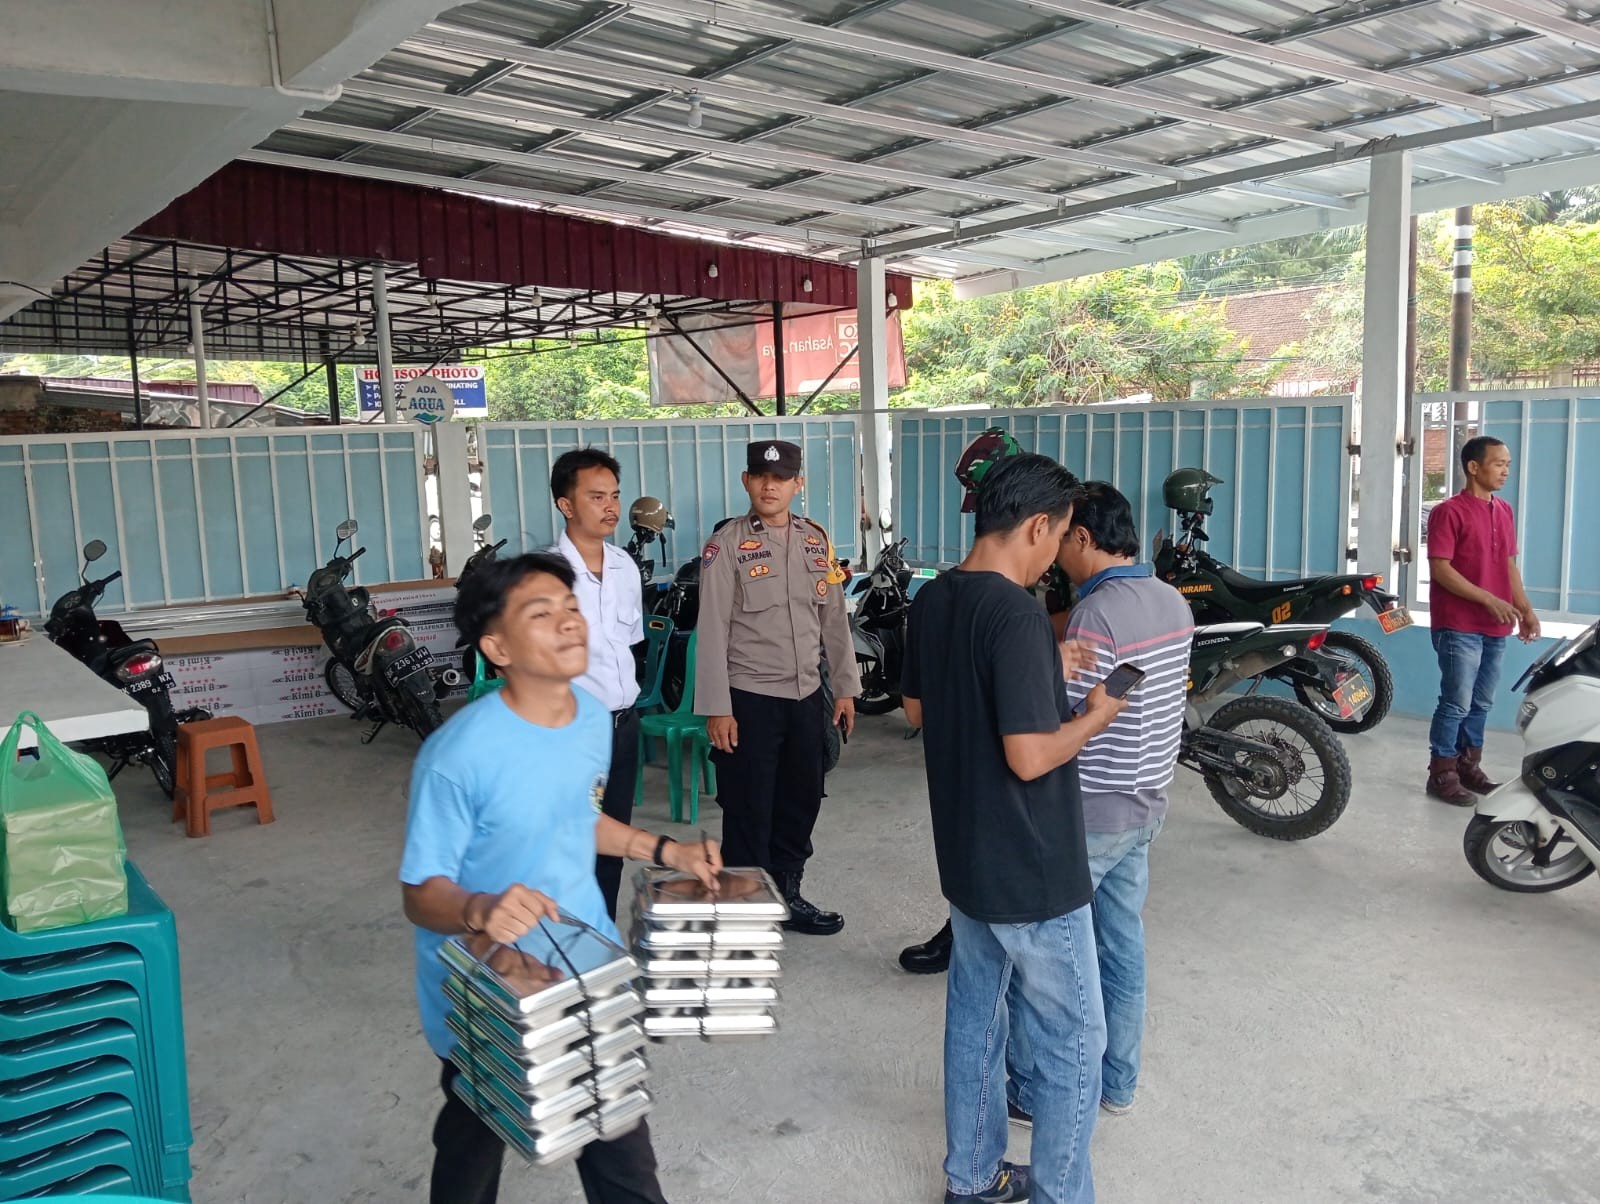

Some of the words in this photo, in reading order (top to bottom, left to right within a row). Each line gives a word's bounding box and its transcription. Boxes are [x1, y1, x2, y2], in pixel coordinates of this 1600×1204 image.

[432, 367, 479, 379] PHOTO
[416, 385, 437, 394] ADA
[409, 397, 445, 412] AQUA
[1271, 601, 1292, 624] 02
[1197, 636, 1231, 647] HONDA
[394, 656, 414, 670] 2361
[130, 679, 152, 693] 2389
[158, 672, 171, 683] NX
[285, 672, 306, 682] Kimi
[183, 683, 207, 694] Kimi
[292, 690, 313, 700] Kimi
[294, 708, 316, 718] Kimi
